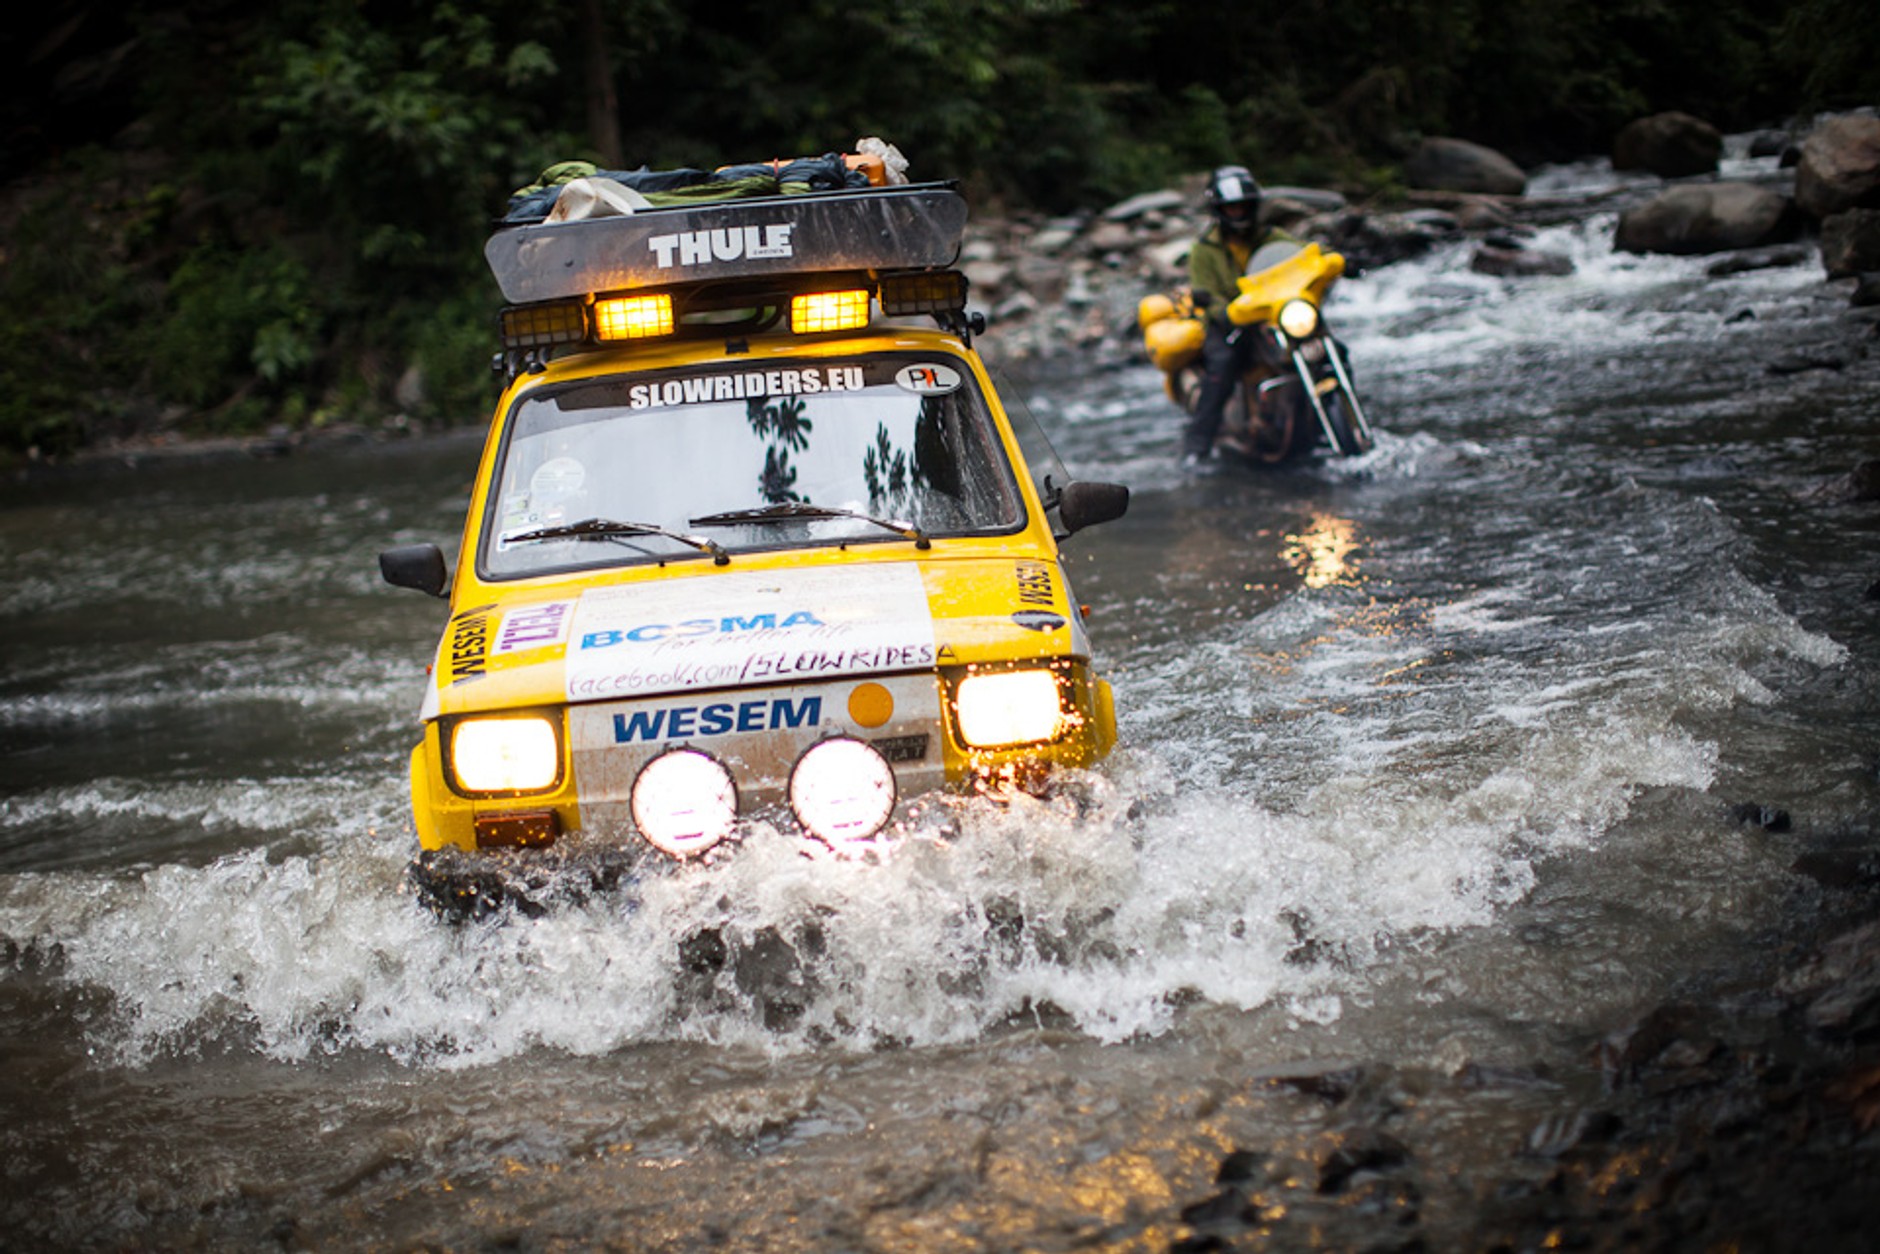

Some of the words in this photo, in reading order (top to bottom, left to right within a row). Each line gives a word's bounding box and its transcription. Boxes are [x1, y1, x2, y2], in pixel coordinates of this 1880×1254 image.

[648, 222, 793, 269] THULE
[629, 366, 865, 410] SLOWRIDERS.EU
[908, 368, 951, 388] PL
[452, 615, 486, 687] WESEM
[613, 696, 822, 744] WESEM
